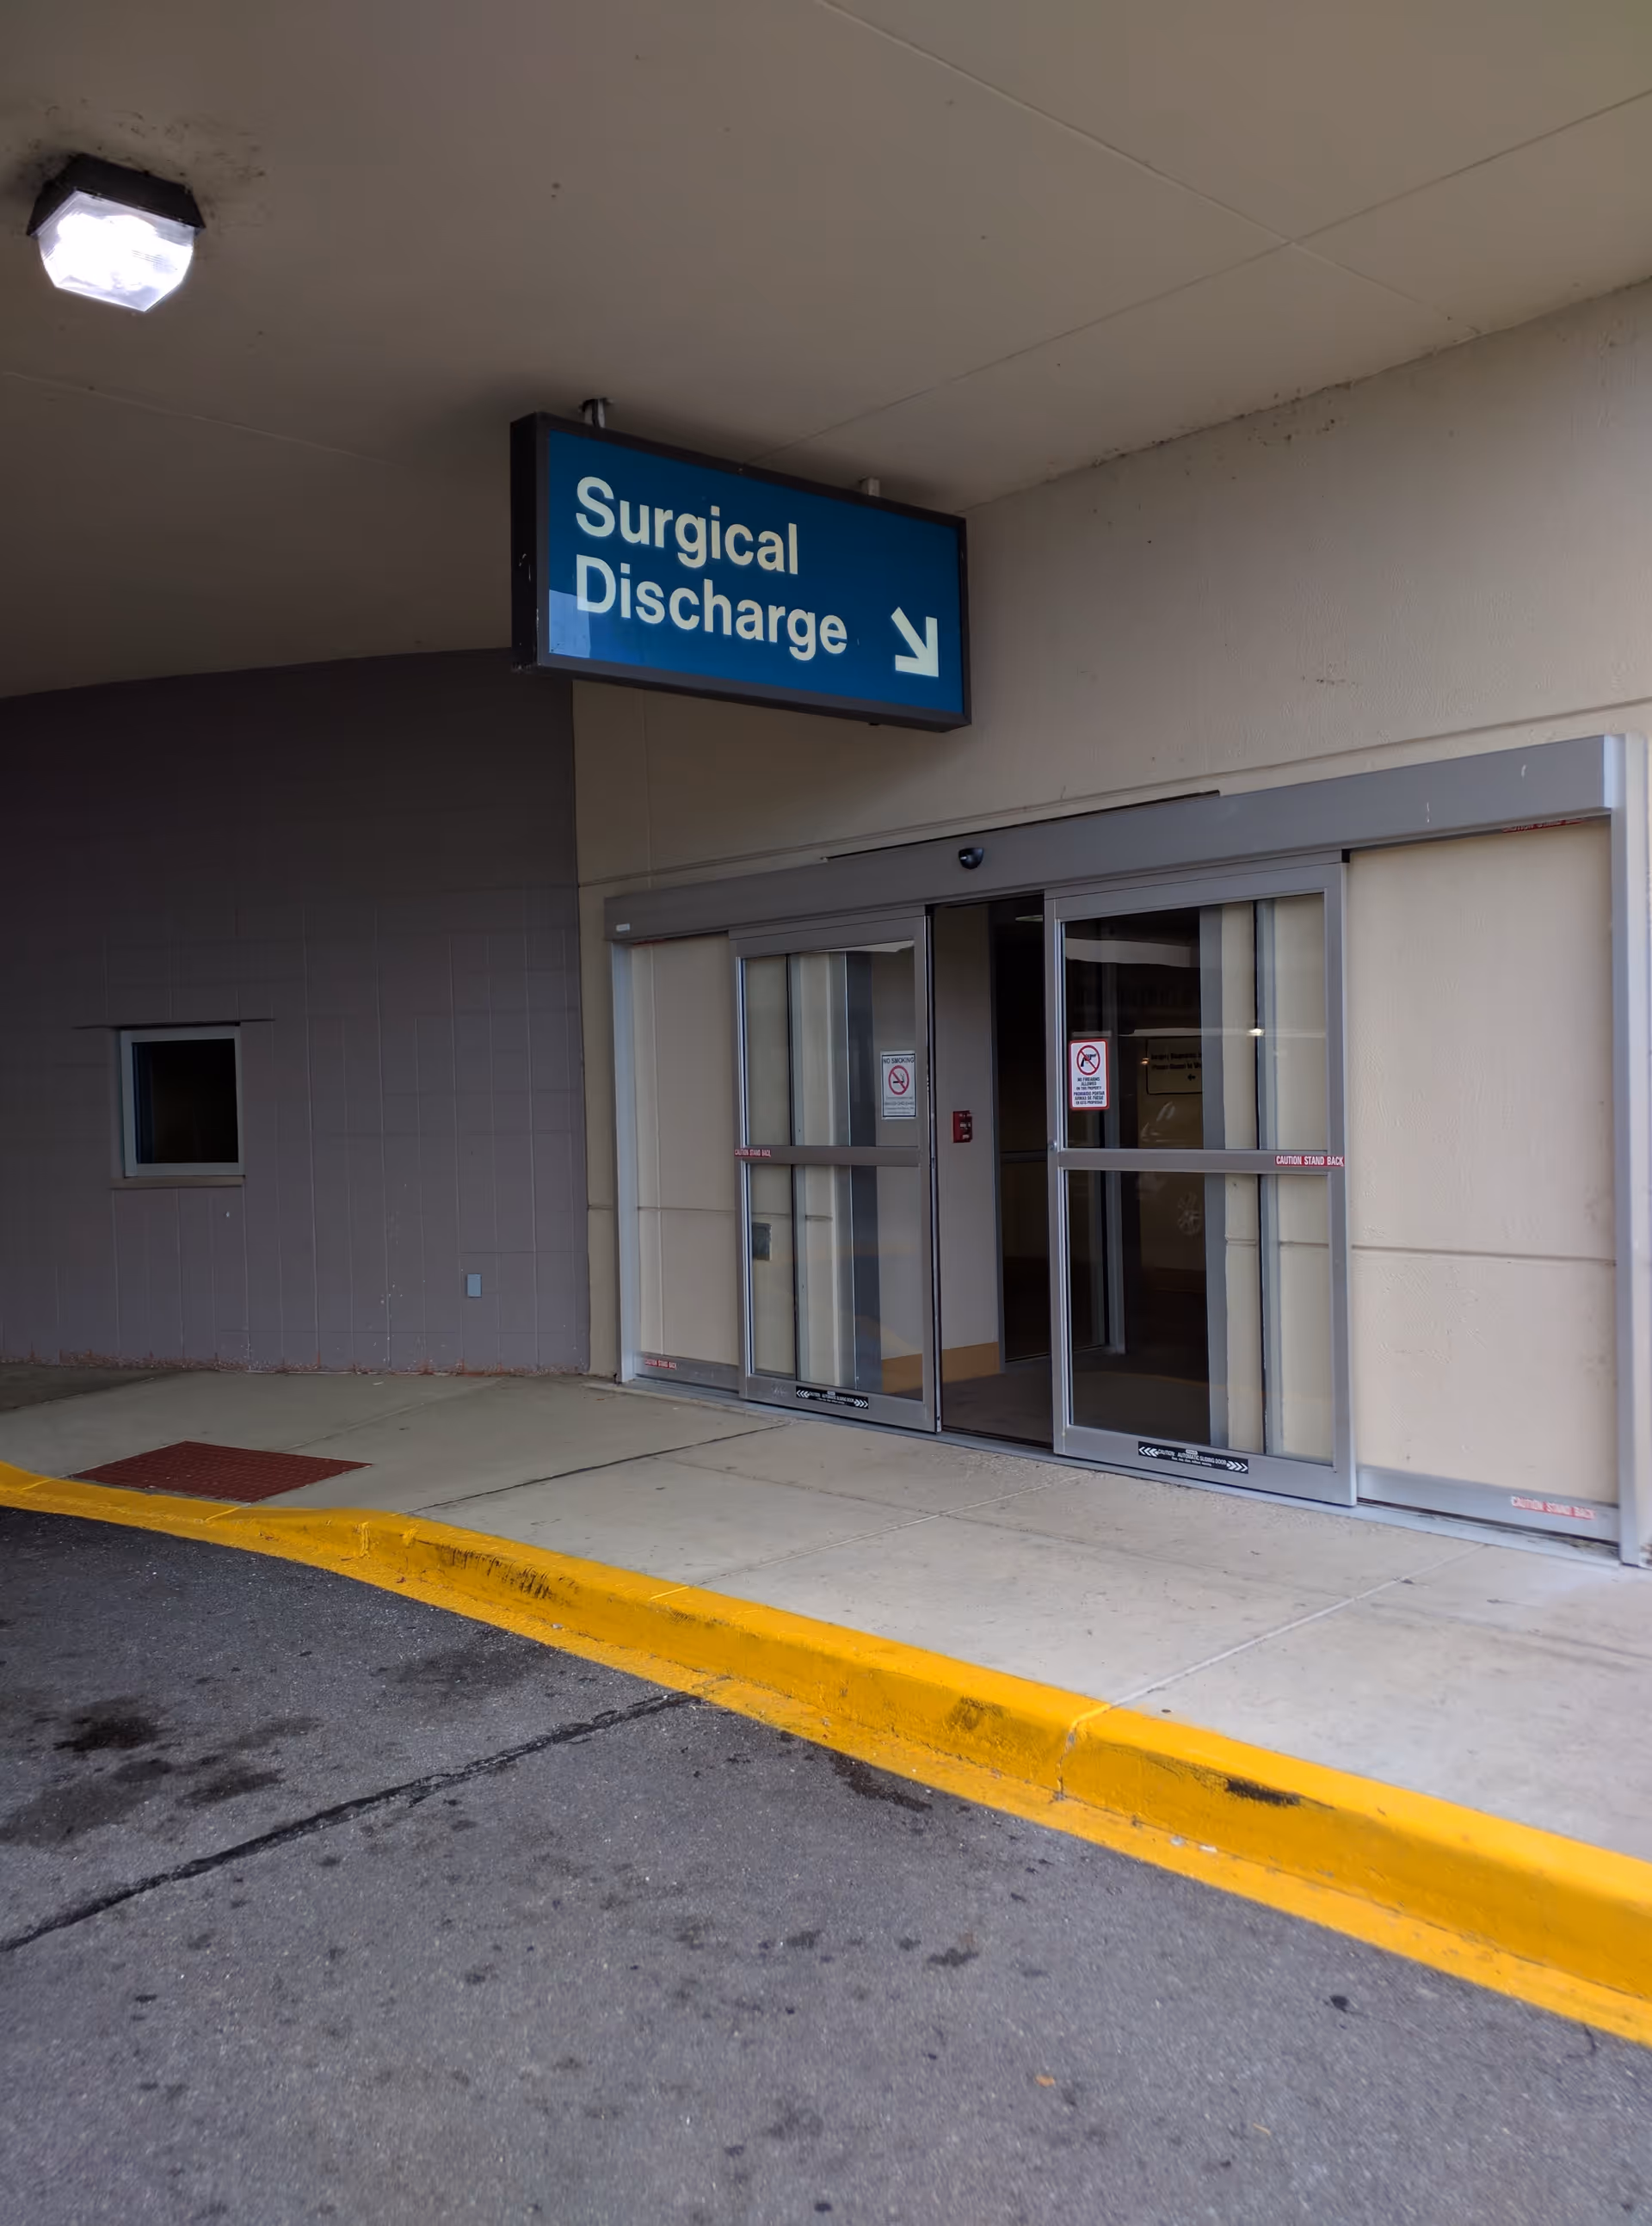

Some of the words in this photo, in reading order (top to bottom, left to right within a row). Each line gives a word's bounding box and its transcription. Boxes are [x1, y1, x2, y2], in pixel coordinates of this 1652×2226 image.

[576, 476, 798, 575] Surgical
[576, 554, 848, 661] Discharge
[1276, 1156, 1302, 1164] CAUTION
[1304, 1156, 1324, 1165] STAND
[1327, 1156, 1344, 1167] BACK
